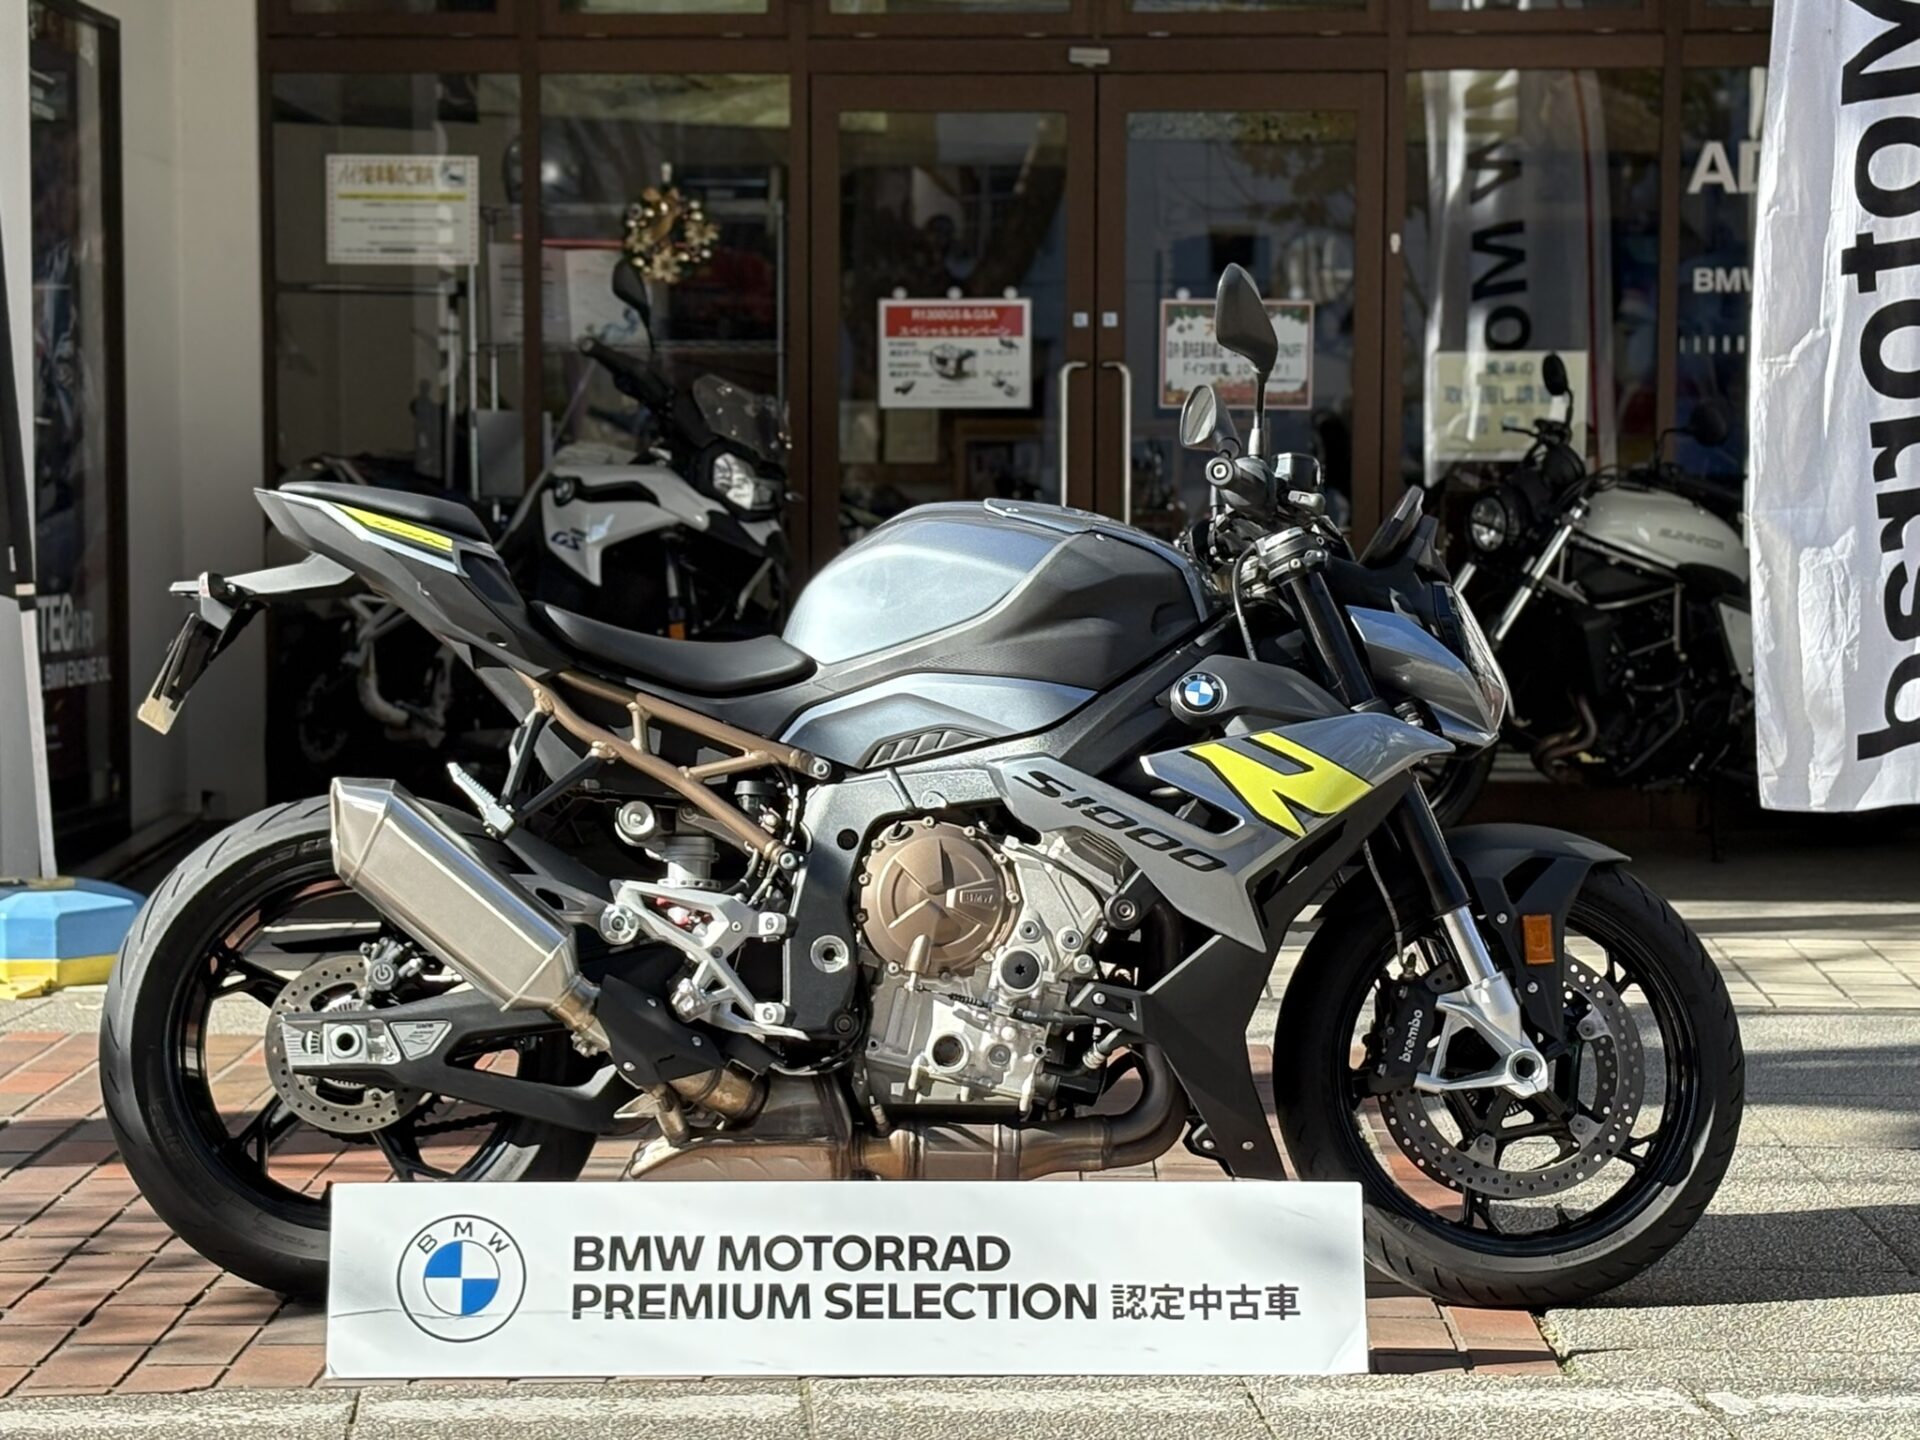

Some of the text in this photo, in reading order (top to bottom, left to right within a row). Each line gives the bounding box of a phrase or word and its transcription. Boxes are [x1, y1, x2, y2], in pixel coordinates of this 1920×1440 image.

[1183, 673, 1220, 690] BMW
[1012, 770, 1228, 872] S1000
[1398, 1009, 1423, 1063] brembo
[417, 1221, 510, 1254] BMW
[574, 1235, 1011, 1271] BMW MOTORRAD
[573, 1282, 1301, 1320] PREMIUM SELECTION 認定中古車
